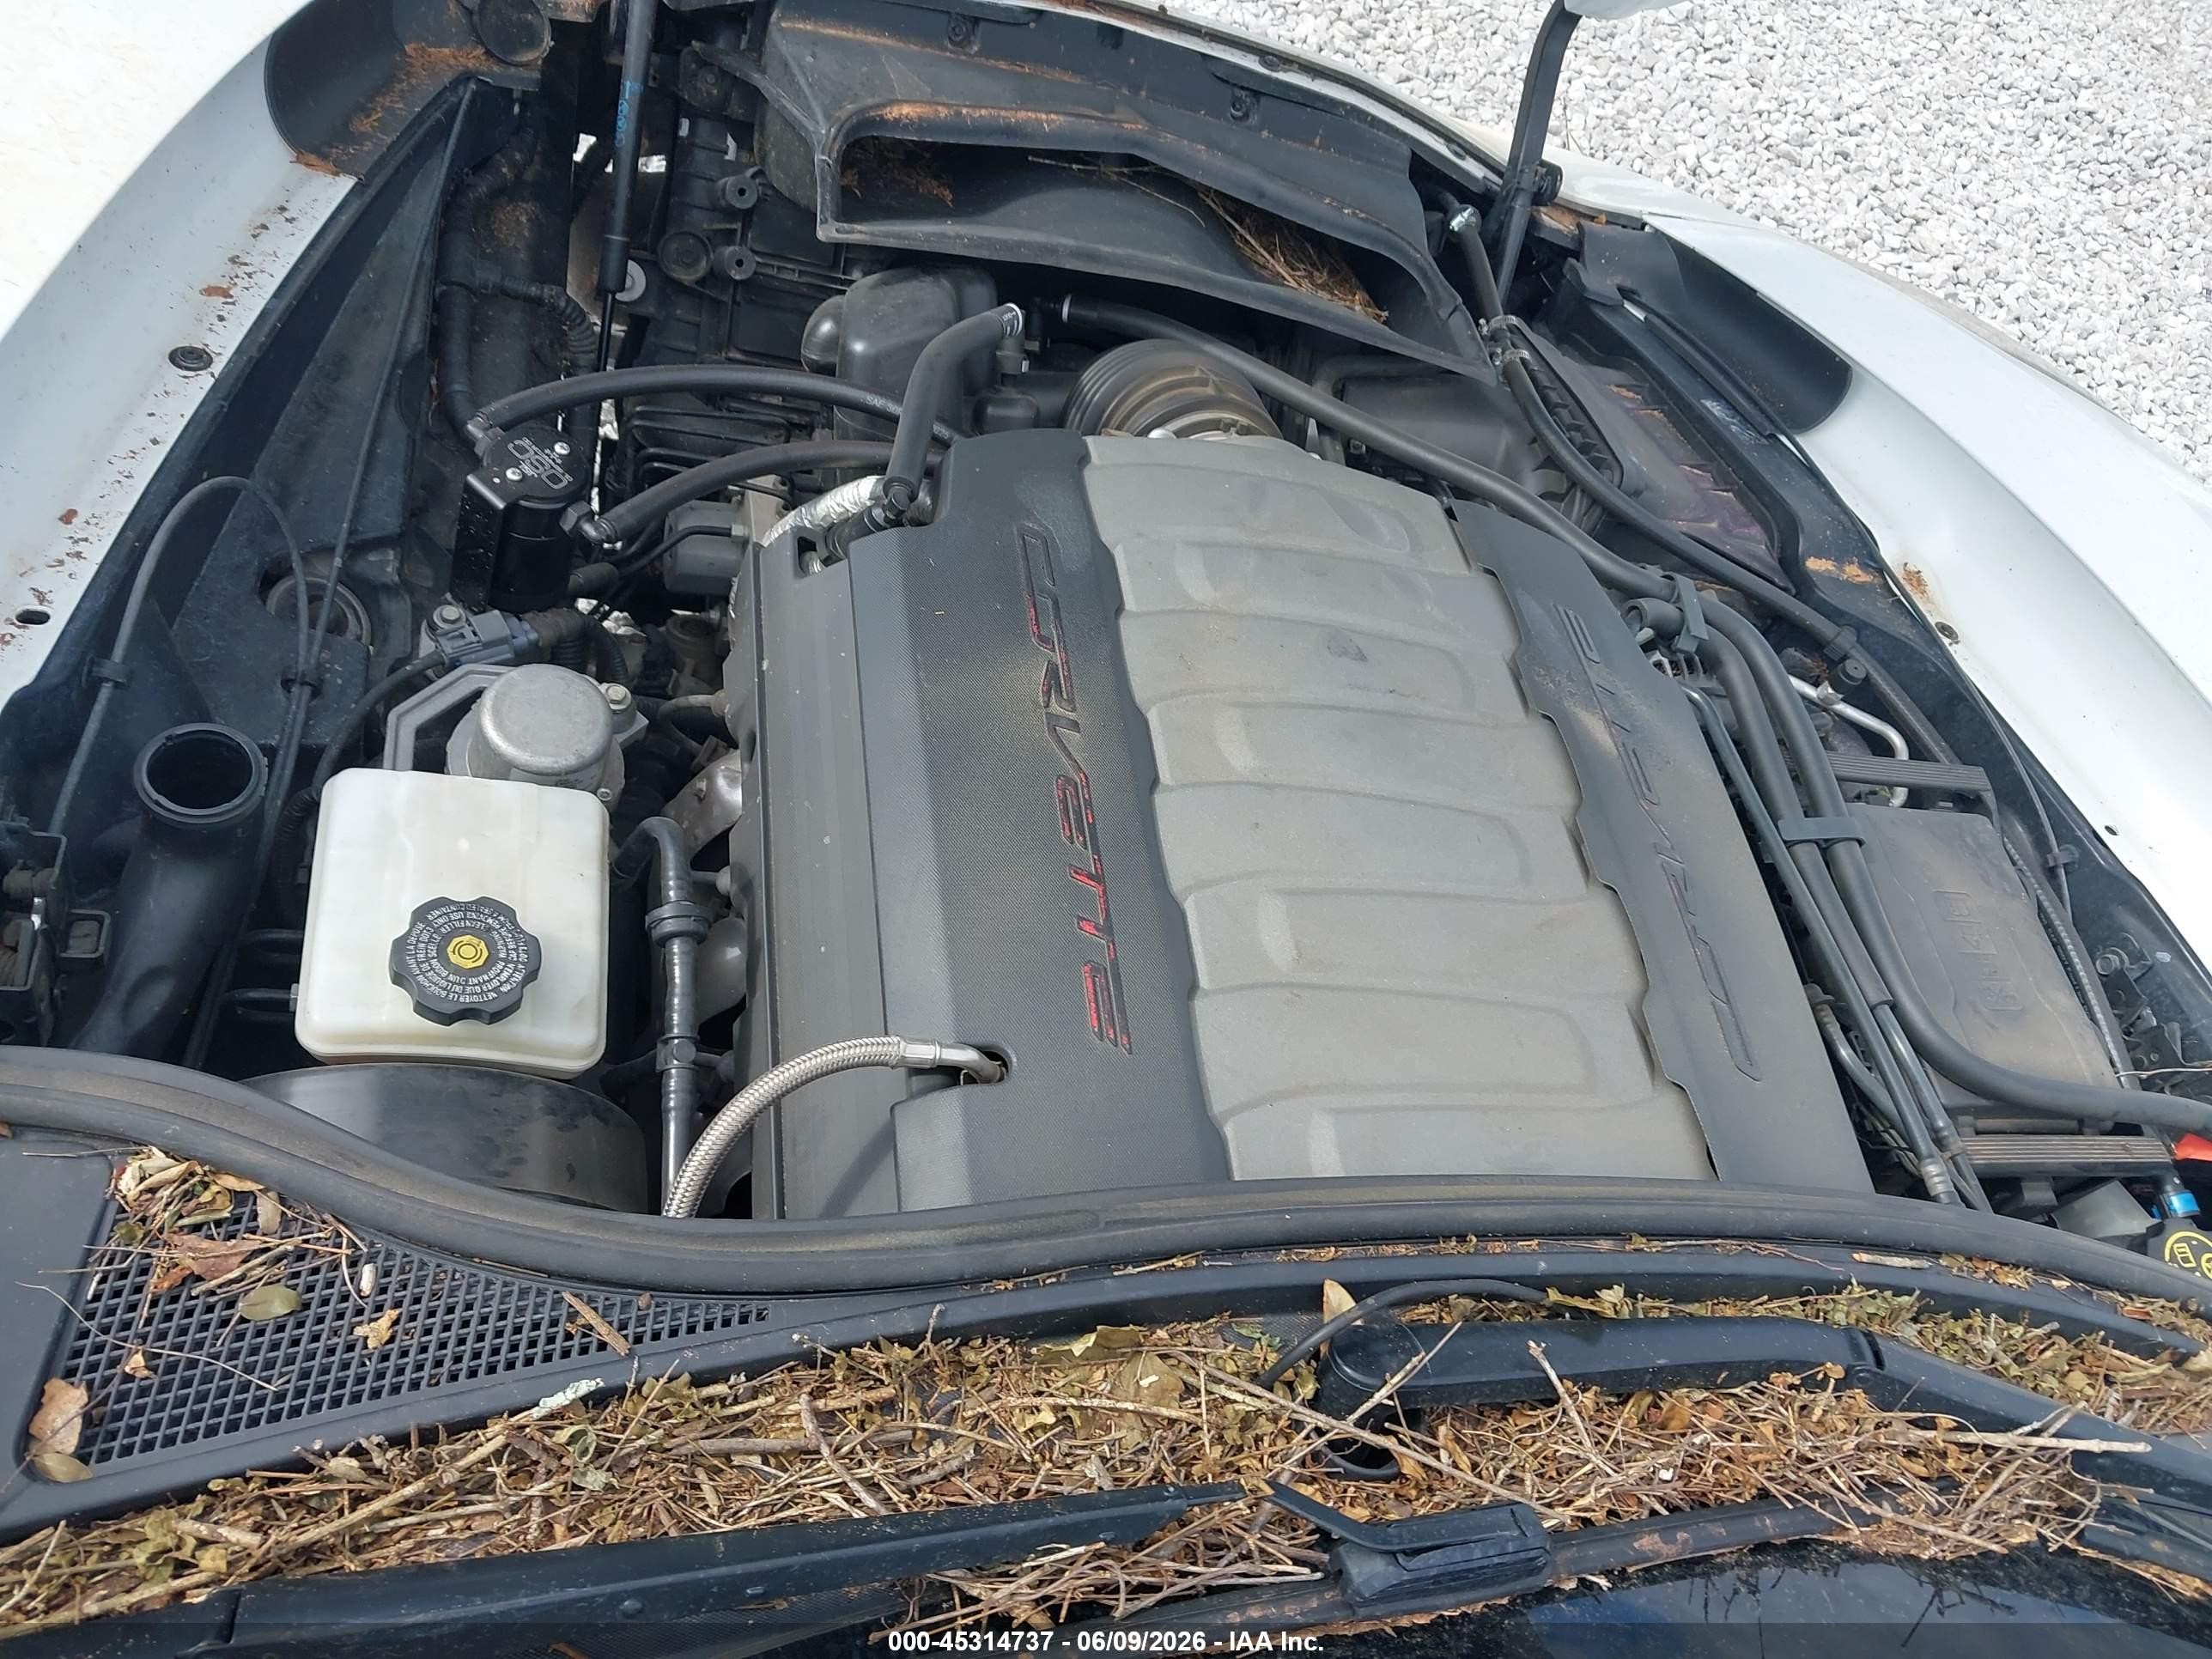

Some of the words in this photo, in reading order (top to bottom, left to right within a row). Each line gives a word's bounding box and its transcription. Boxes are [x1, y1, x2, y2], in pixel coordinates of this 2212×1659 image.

[507, 440, 568, 489] OSC
[1016, 521, 1133, 1055] CORVETTE
[431, 915, 449, 927] ONLY
[448, 912, 464, 921] USE
[439, 921, 465, 933] FILLER
[407, 945, 415, 953] LA
[416, 942, 426, 961] FREIN
[405, 955, 420, 975] AVANT
[420, 962, 430, 972] DE
[451, 984, 463, 994] DU
[447, 992, 458, 1001] LE
[459, 992, 497, 1002] NETTOYER
